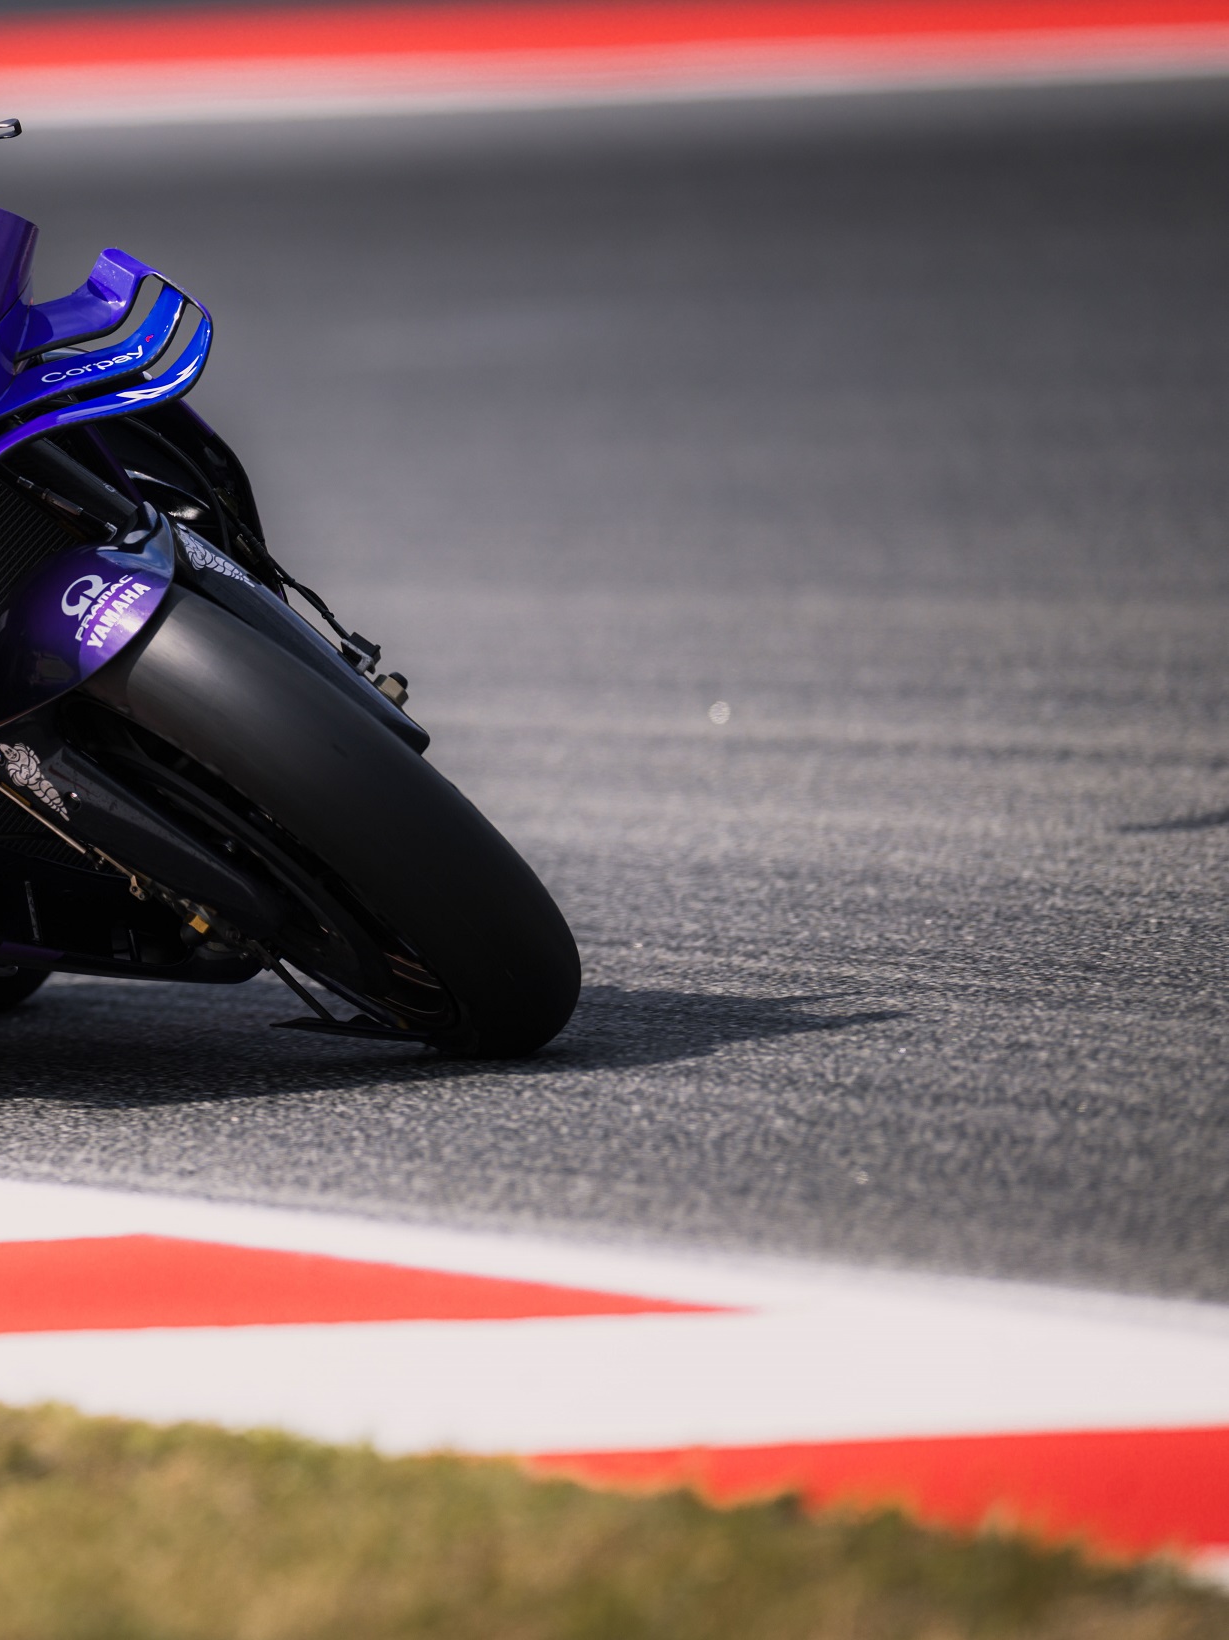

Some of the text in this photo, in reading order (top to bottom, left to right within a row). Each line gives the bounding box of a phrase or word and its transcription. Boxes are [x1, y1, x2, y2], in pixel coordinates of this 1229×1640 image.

[41, 344, 145, 384] Corpay
[75, 574, 134, 642] PRAMAC
[86, 582, 152, 649] YAMAHA
